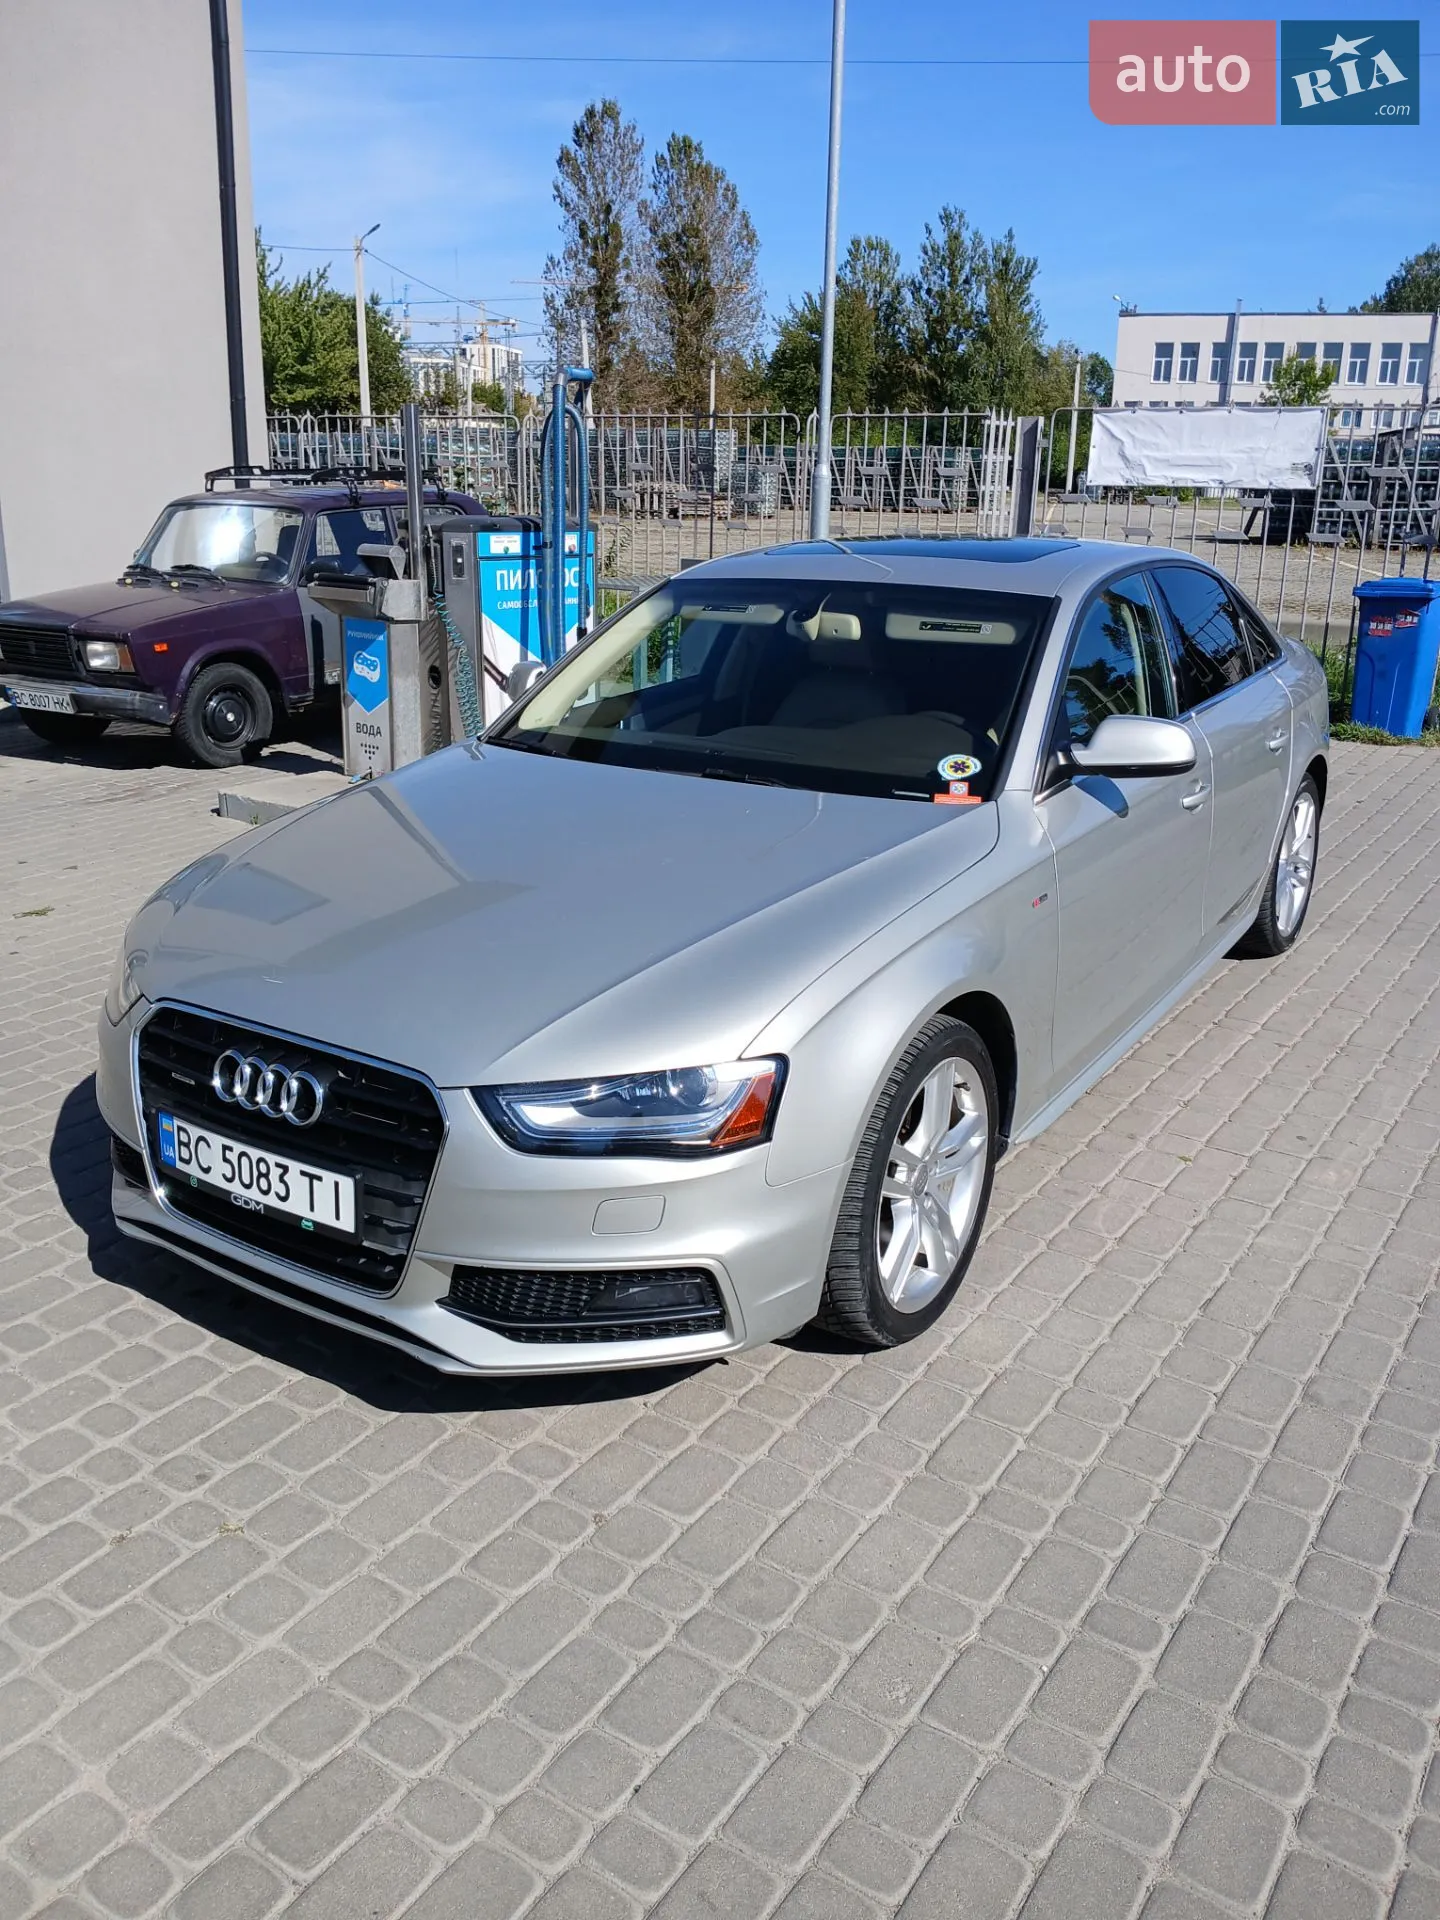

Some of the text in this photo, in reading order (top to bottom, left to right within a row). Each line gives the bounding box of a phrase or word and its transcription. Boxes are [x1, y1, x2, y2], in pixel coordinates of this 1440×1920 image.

[496, 567, 580, 591] ПИЛОС
[29, 693, 50, 709] 8007
[356, 722, 382, 737] ВОДА
[163, 1143, 175, 1158] UA
[176, 1124, 212, 1174] BC
[221, 1143, 291, 1203] 5083
[230, 1193, 265, 1214] GDM
